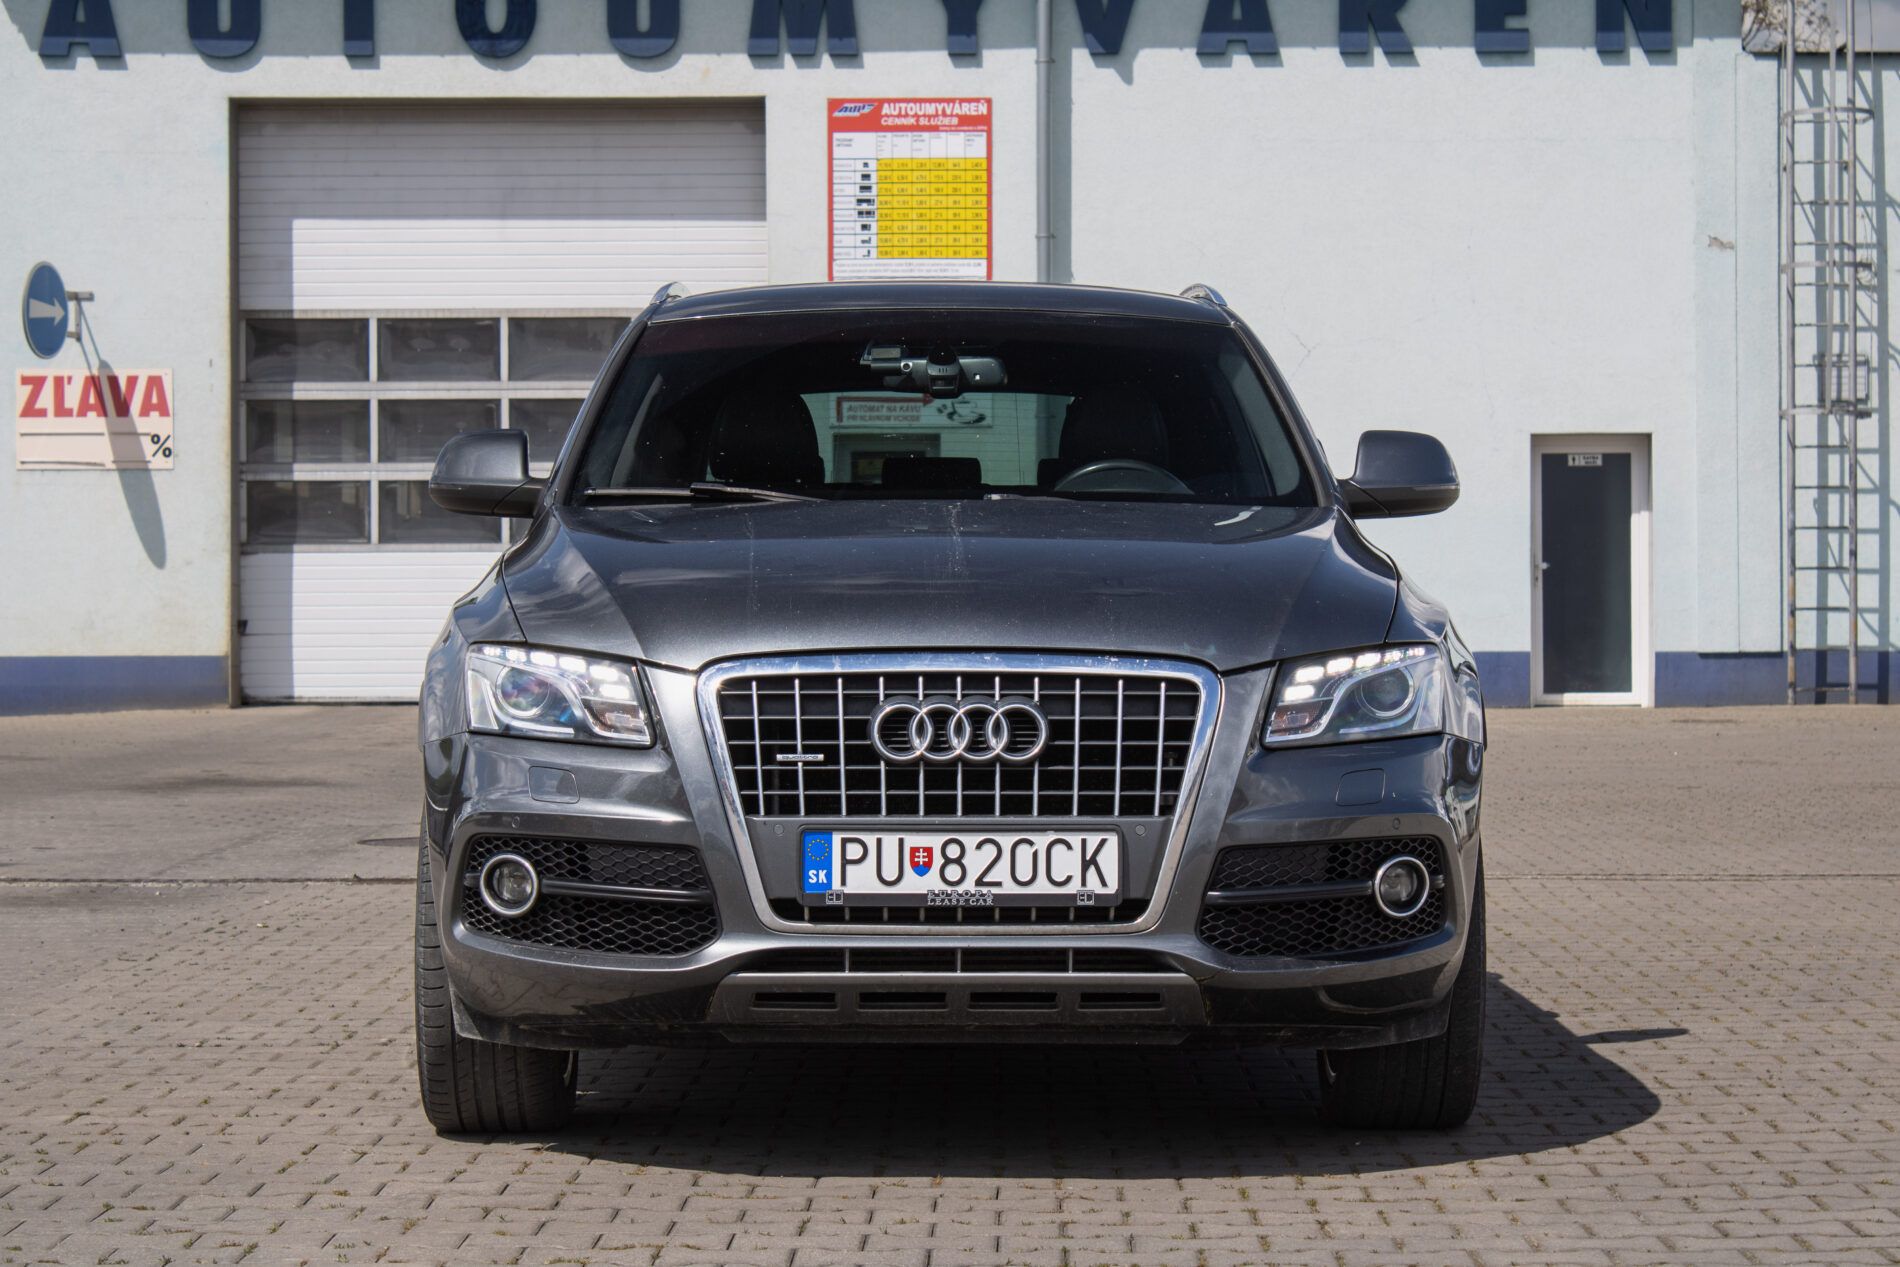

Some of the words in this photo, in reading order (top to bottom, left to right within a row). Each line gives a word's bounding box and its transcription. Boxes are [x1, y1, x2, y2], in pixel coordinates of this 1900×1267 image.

[881, 100, 987, 115] AUTOUMYVÁREŇ
[881, 116, 916, 126] CENNÍK
[919, 116, 958, 126] SLUŽIEB
[19, 374, 171, 418] ZĽAVA
[150, 433, 172, 458] %
[839, 836, 905, 887] PU
[938, 836, 1109, 888] 820CK
[808, 870, 828, 884] SK
[927, 889, 994, 898] EUROPA
[927, 898, 966, 906] LEASE
[969, 898, 994, 906] CAR
